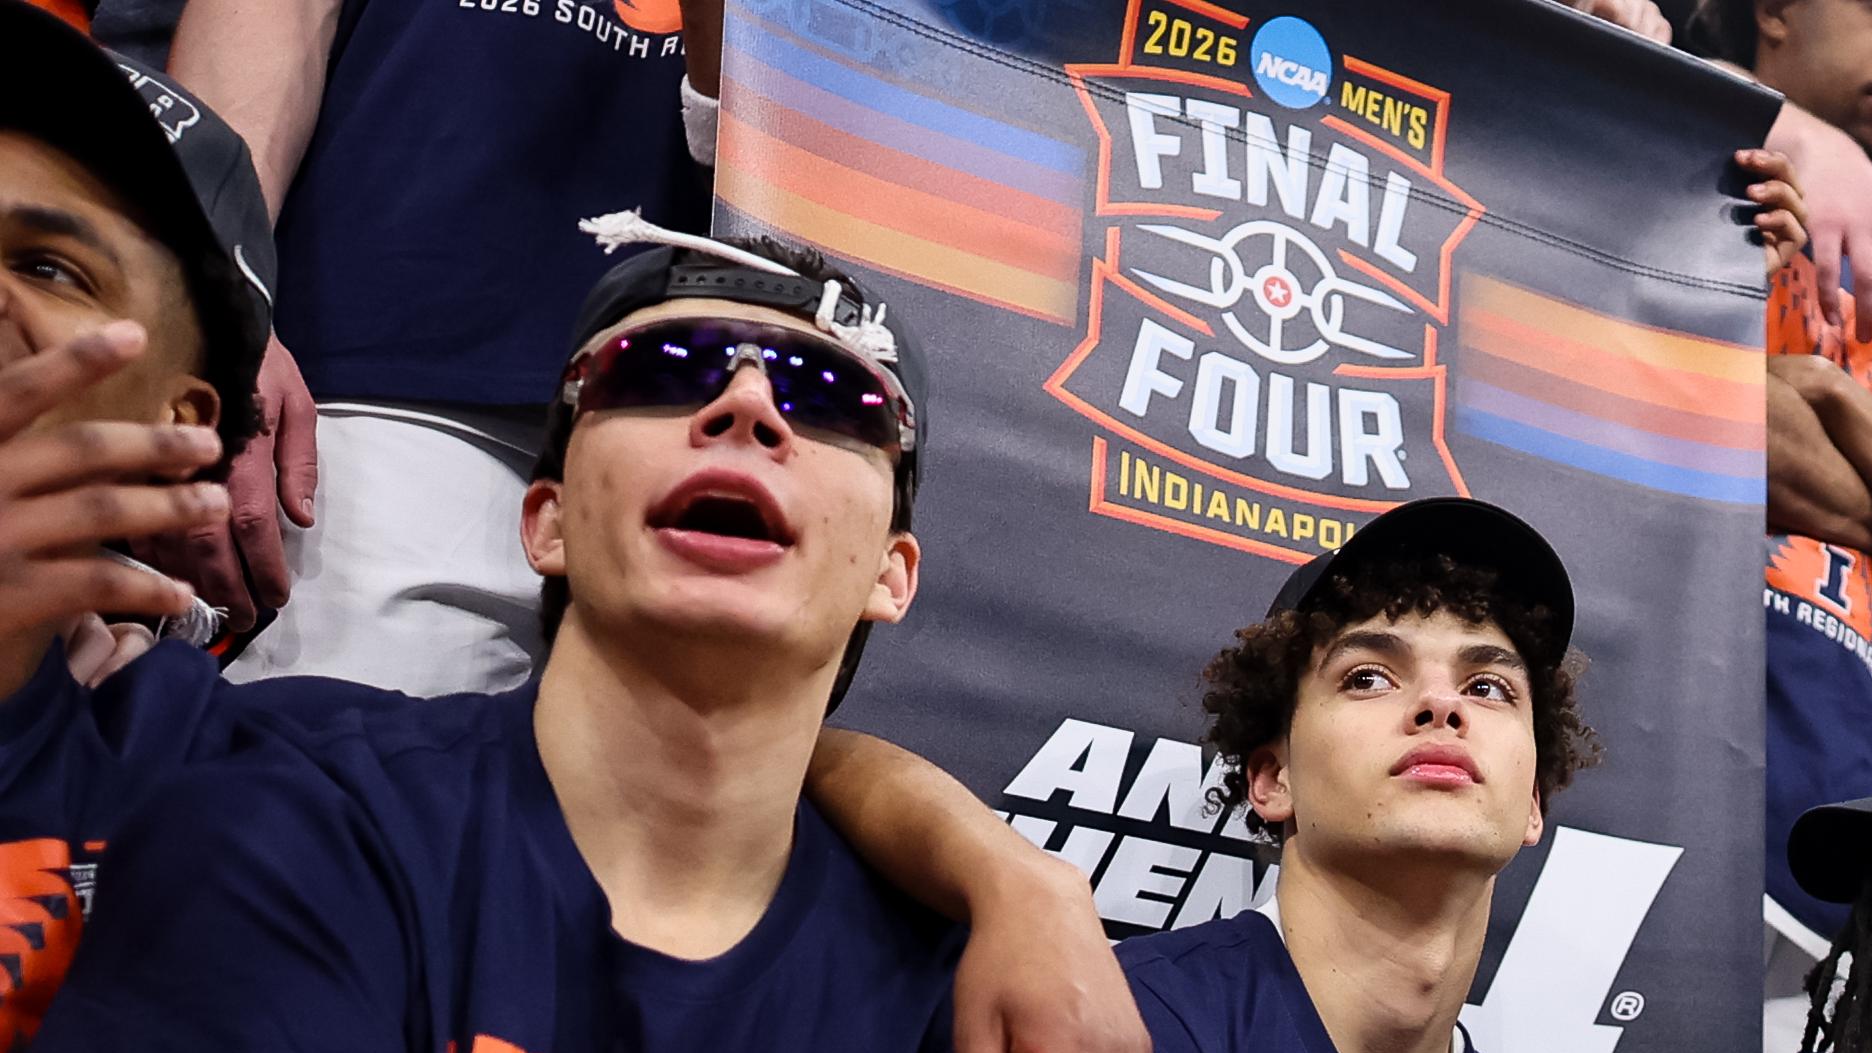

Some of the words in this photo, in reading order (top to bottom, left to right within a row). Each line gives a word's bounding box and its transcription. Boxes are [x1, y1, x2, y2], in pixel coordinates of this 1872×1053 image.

[554, 0, 650, 58] SOUTH
[1144, 11, 1238, 66] 2026
[1256, 51, 1328, 97] NCAA
[1340, 80, 1428, 150] MEN'S
[1125, 91, 1418, 273] FINAL
[1118, 317, 1411, 490] FOUR
[1002, 717, 1281, 847] AN
[993, 808, 1281, 932] HEN
